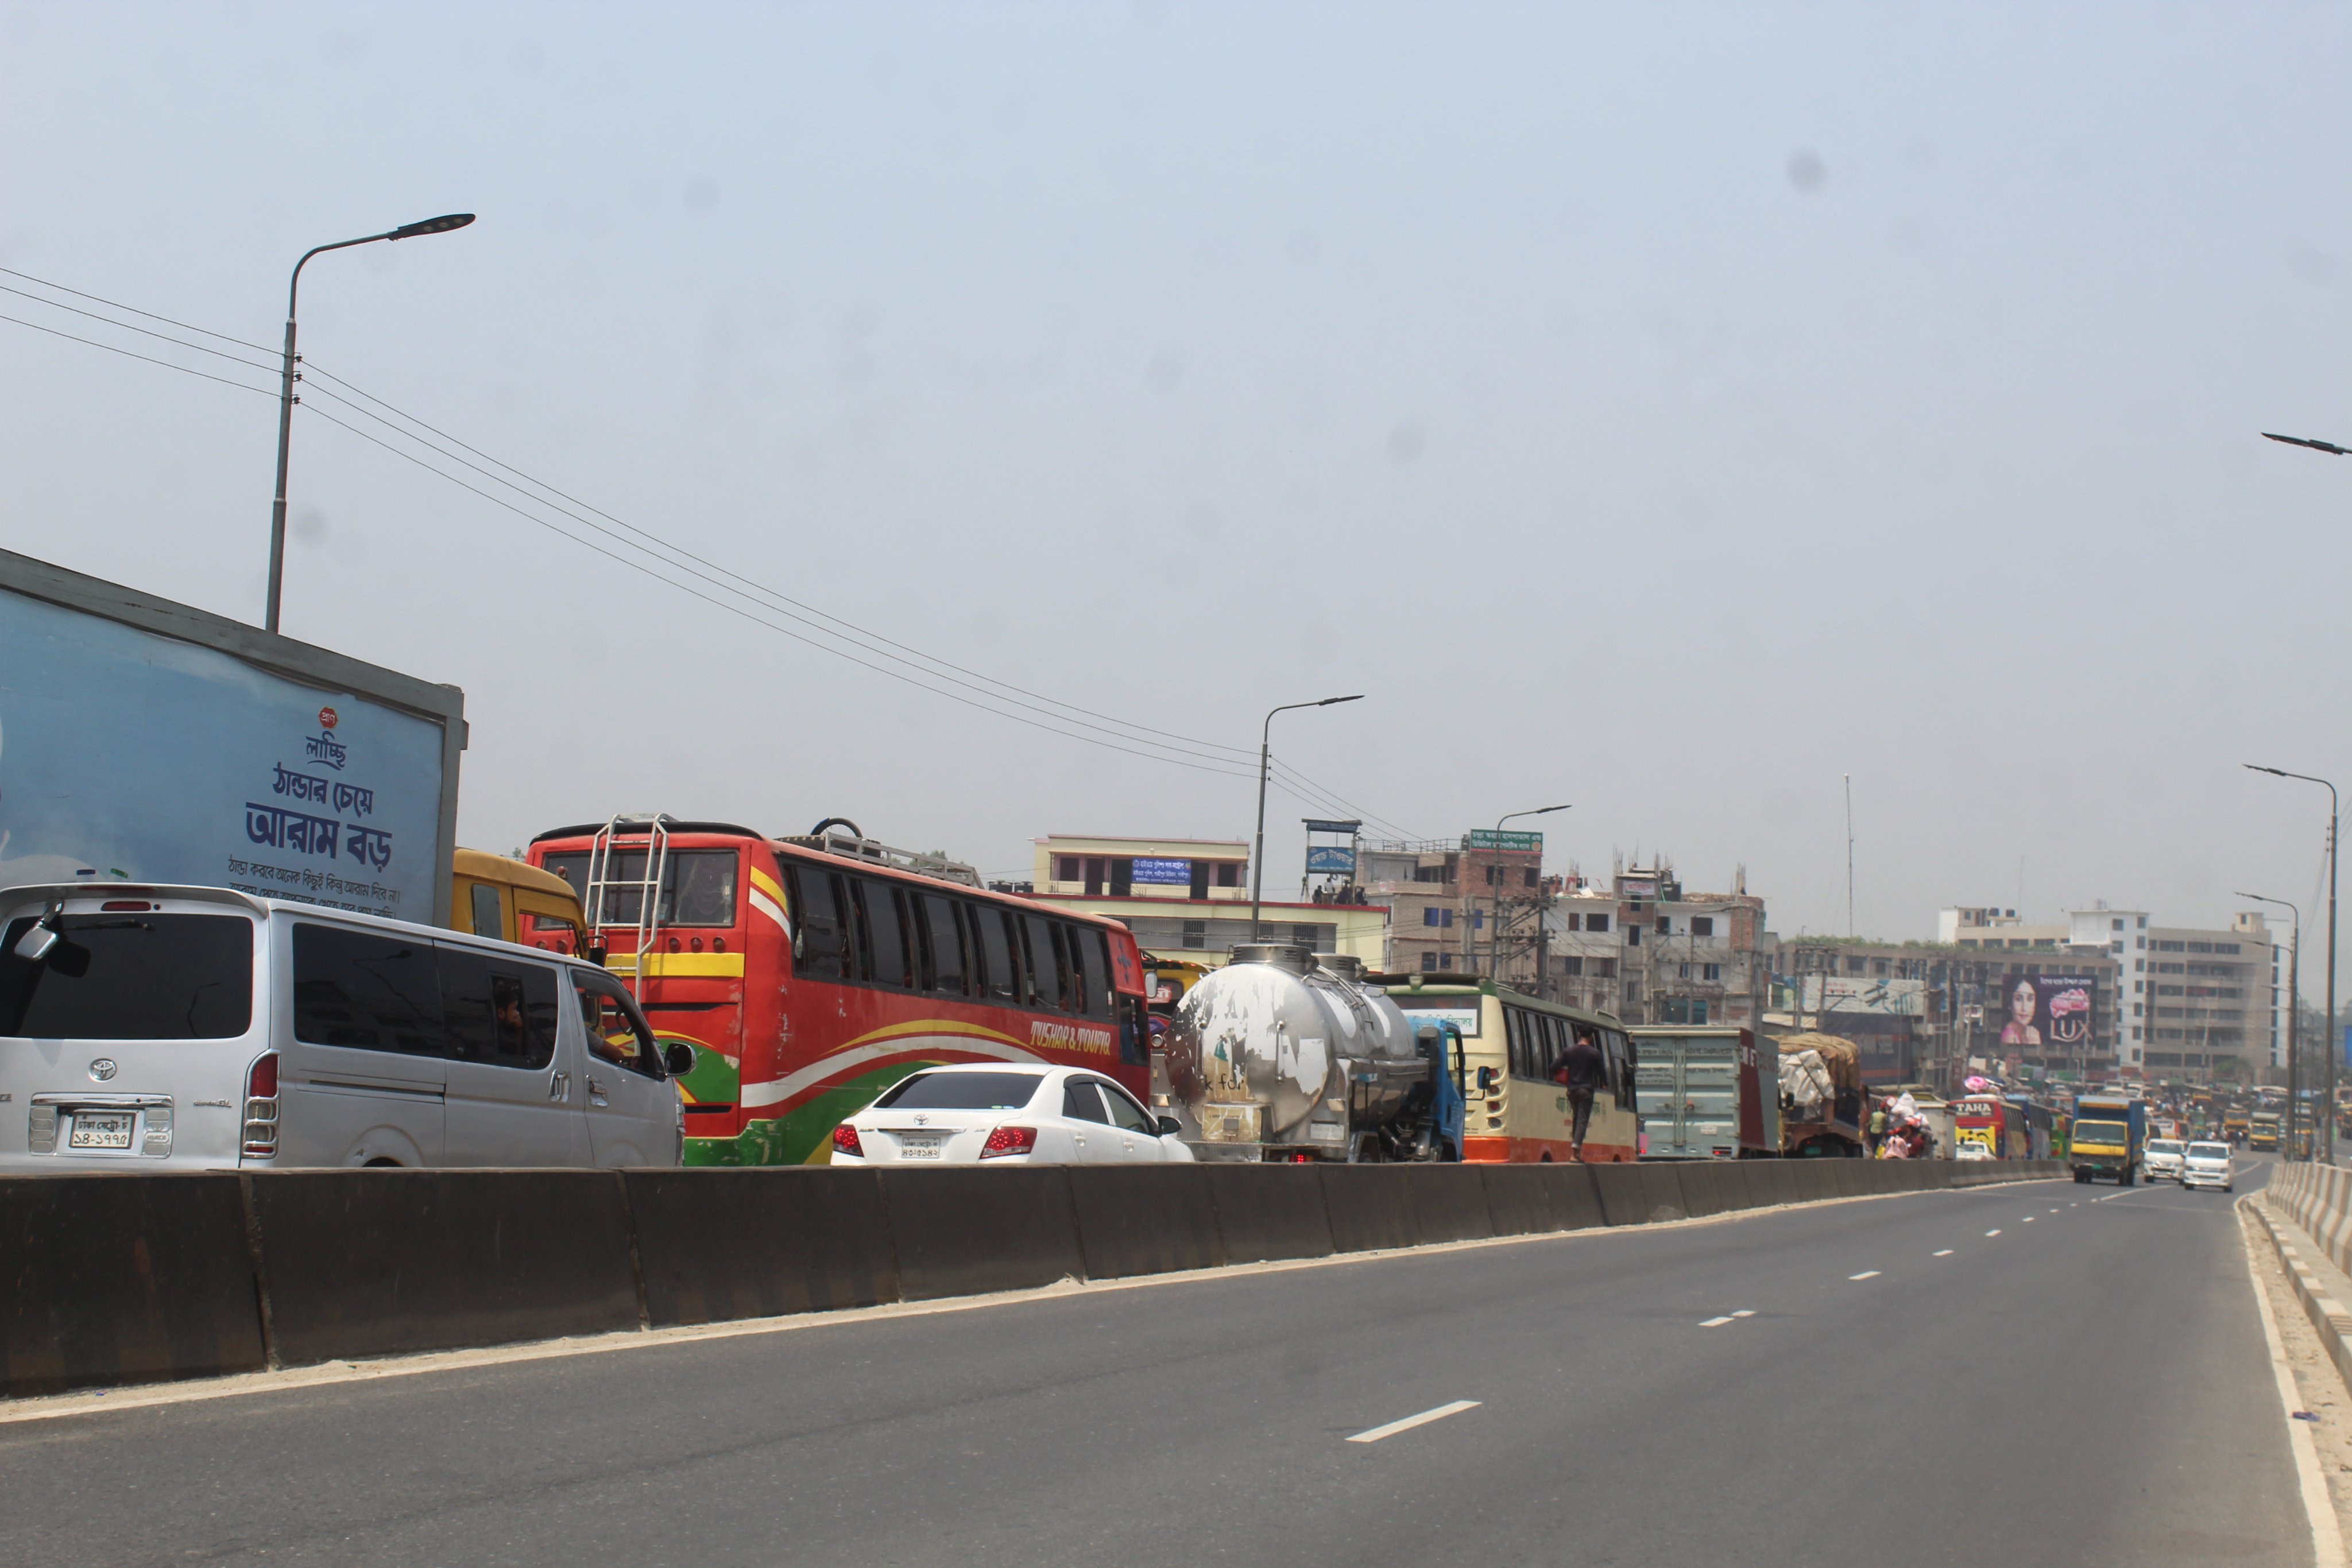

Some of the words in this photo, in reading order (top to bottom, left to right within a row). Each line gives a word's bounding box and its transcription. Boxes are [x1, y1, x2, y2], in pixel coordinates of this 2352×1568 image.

[305, 730, 347, 770] লাচ্ছি
[273, 761, 328, 804] ঠান্ডার
[333, 783, 373, 818] চেয়ে
[246, 802, 340, 859] আরাম
[347, 824, 393, 873] বড়
[229, 854, 248, 875] ঠান্ডা
[250, 863, 274, 879] করবে
[276, 868, 300, 884] অনেক
[303, 869, 323, 892] কিছুই
[326, 873, 343, 894] কিন্তু
[345, 881, 369, 897] আরাম
[371, 882, 387, 900] দিবে
[1030, 1021, 1069, 1050] TUSHAR
[1069, 1027, 1077, 1051] &
[2050, 1019, 2095, 1043] LUX
[1218, 1074, 1244, 1090] for
[1956, 1103, 1993, 1112] TAHA
[78, 1121, 95, 1129] ঢাকা
